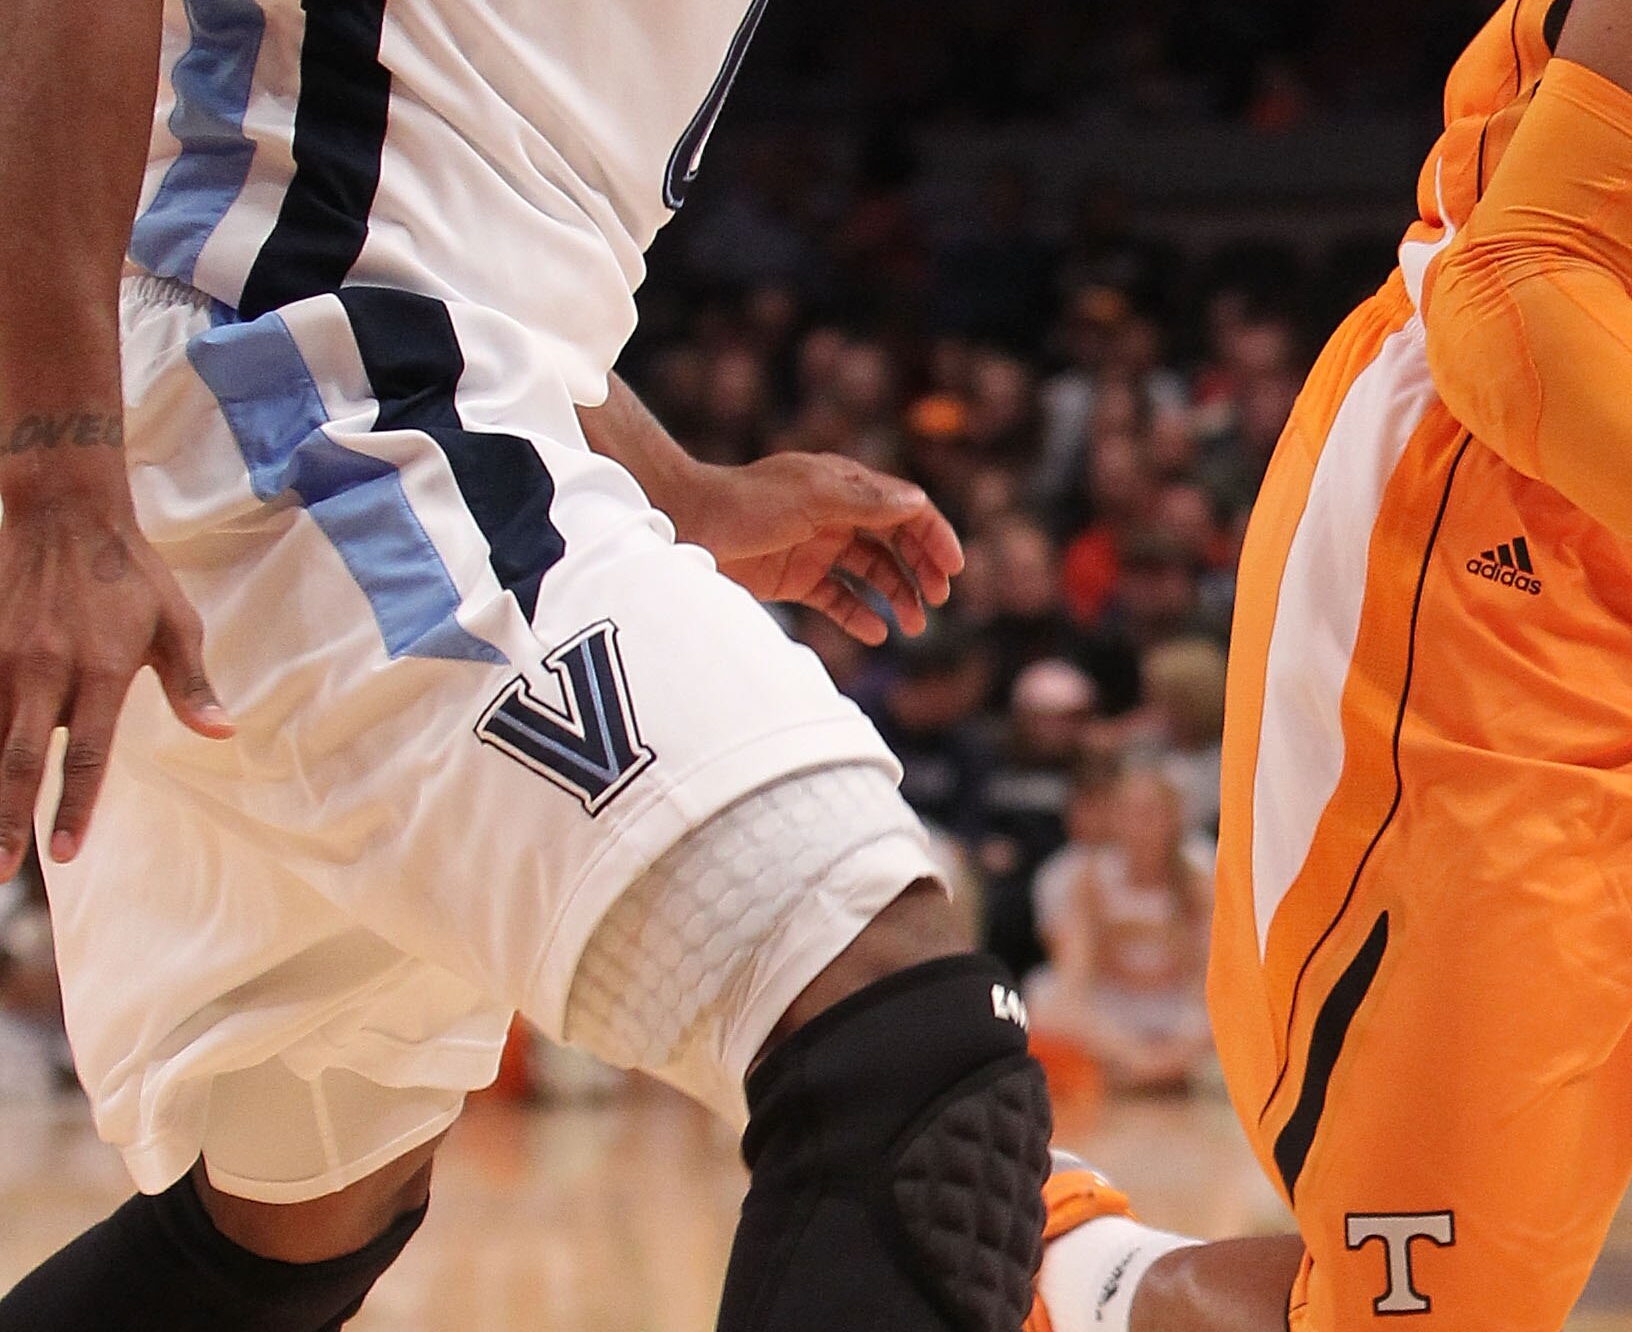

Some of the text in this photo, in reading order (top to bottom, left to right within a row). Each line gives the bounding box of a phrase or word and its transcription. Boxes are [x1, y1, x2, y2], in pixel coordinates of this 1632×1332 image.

[1466, 559, 1542, 595] adidas
[473, 618, 657, 818] V
[1345, 1209, 1455, 1316] T
